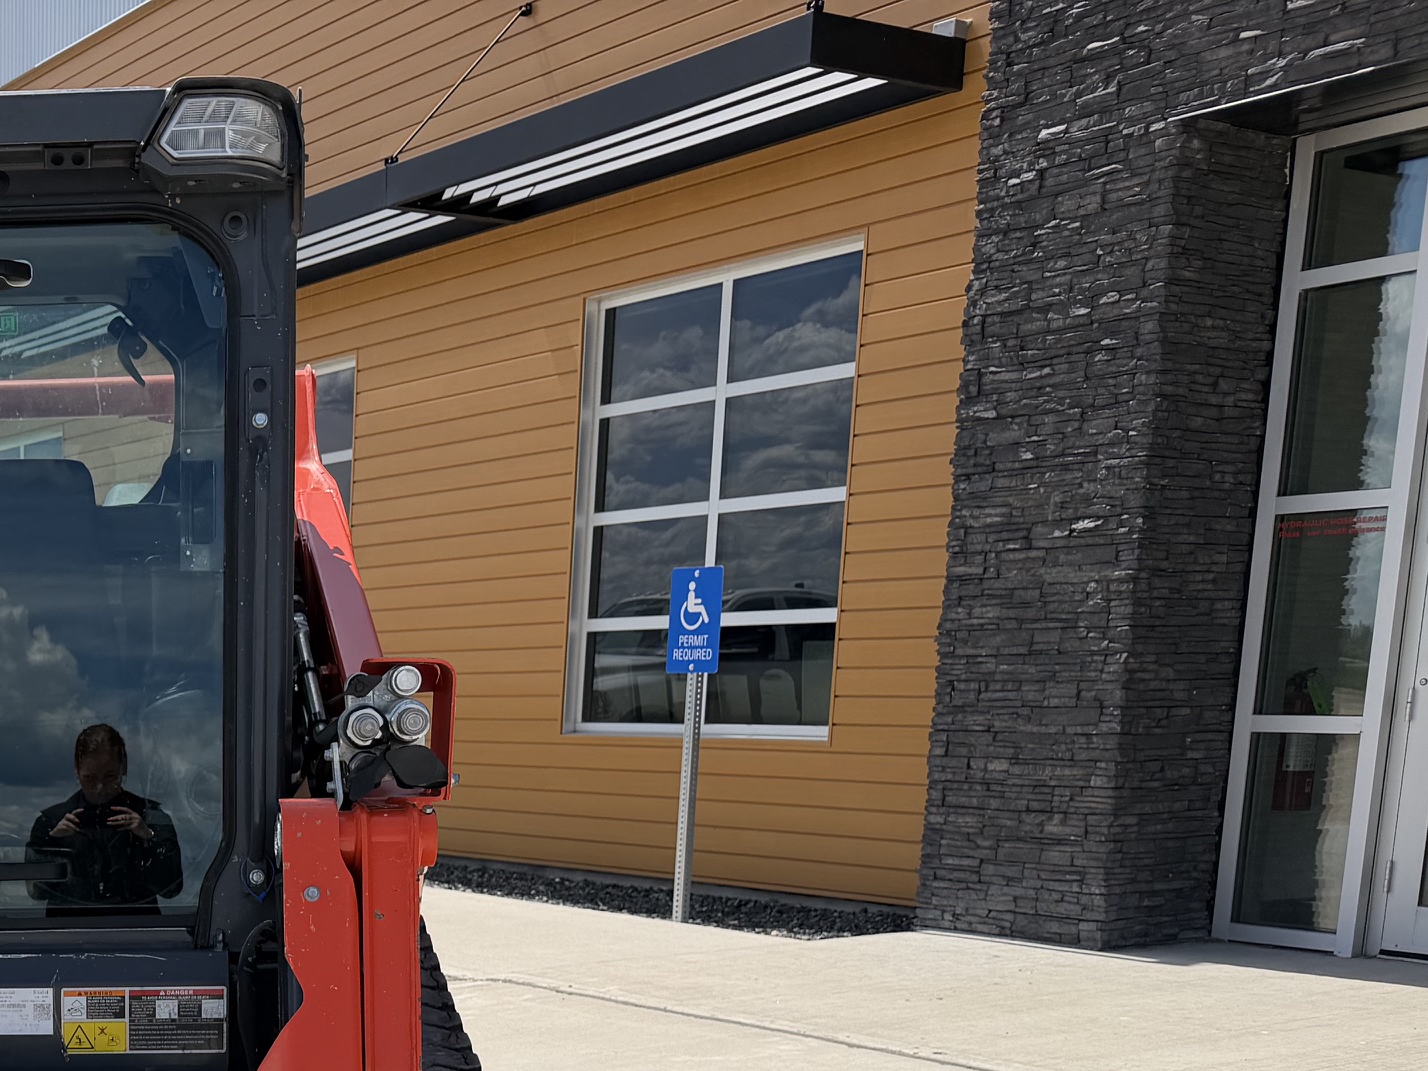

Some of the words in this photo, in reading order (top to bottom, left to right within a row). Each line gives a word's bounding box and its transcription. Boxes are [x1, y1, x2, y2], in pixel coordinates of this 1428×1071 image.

[1330, 516, 1354, 526] HOSE
[1355, 514, 1388, 524] REPAIR
[678, 634, 709, 647] PERMIT
[672, 648, 713, 661] REQUIRED
